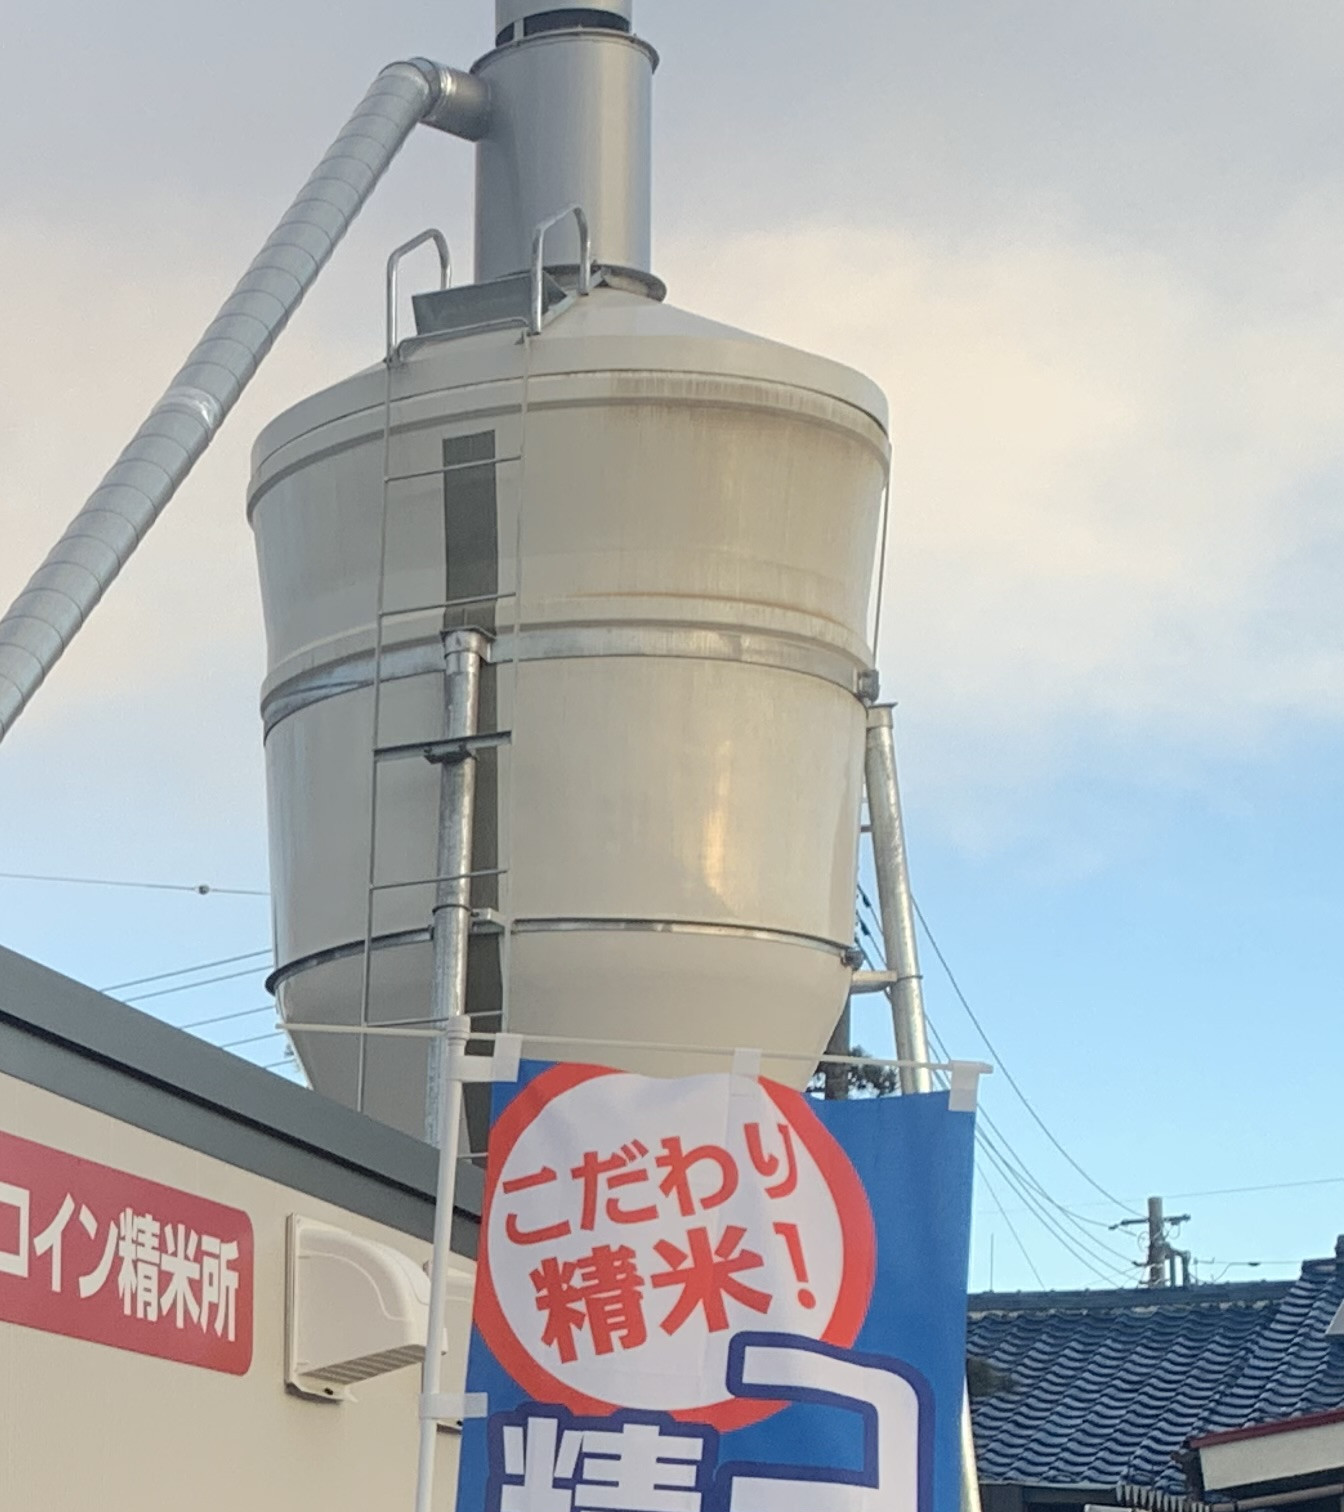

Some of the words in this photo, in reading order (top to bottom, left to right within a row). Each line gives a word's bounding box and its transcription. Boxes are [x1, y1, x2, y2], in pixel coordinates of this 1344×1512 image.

[501, 1121, 799, 1246] こだわり
[529, 1220, 817, 1364] 精米！
